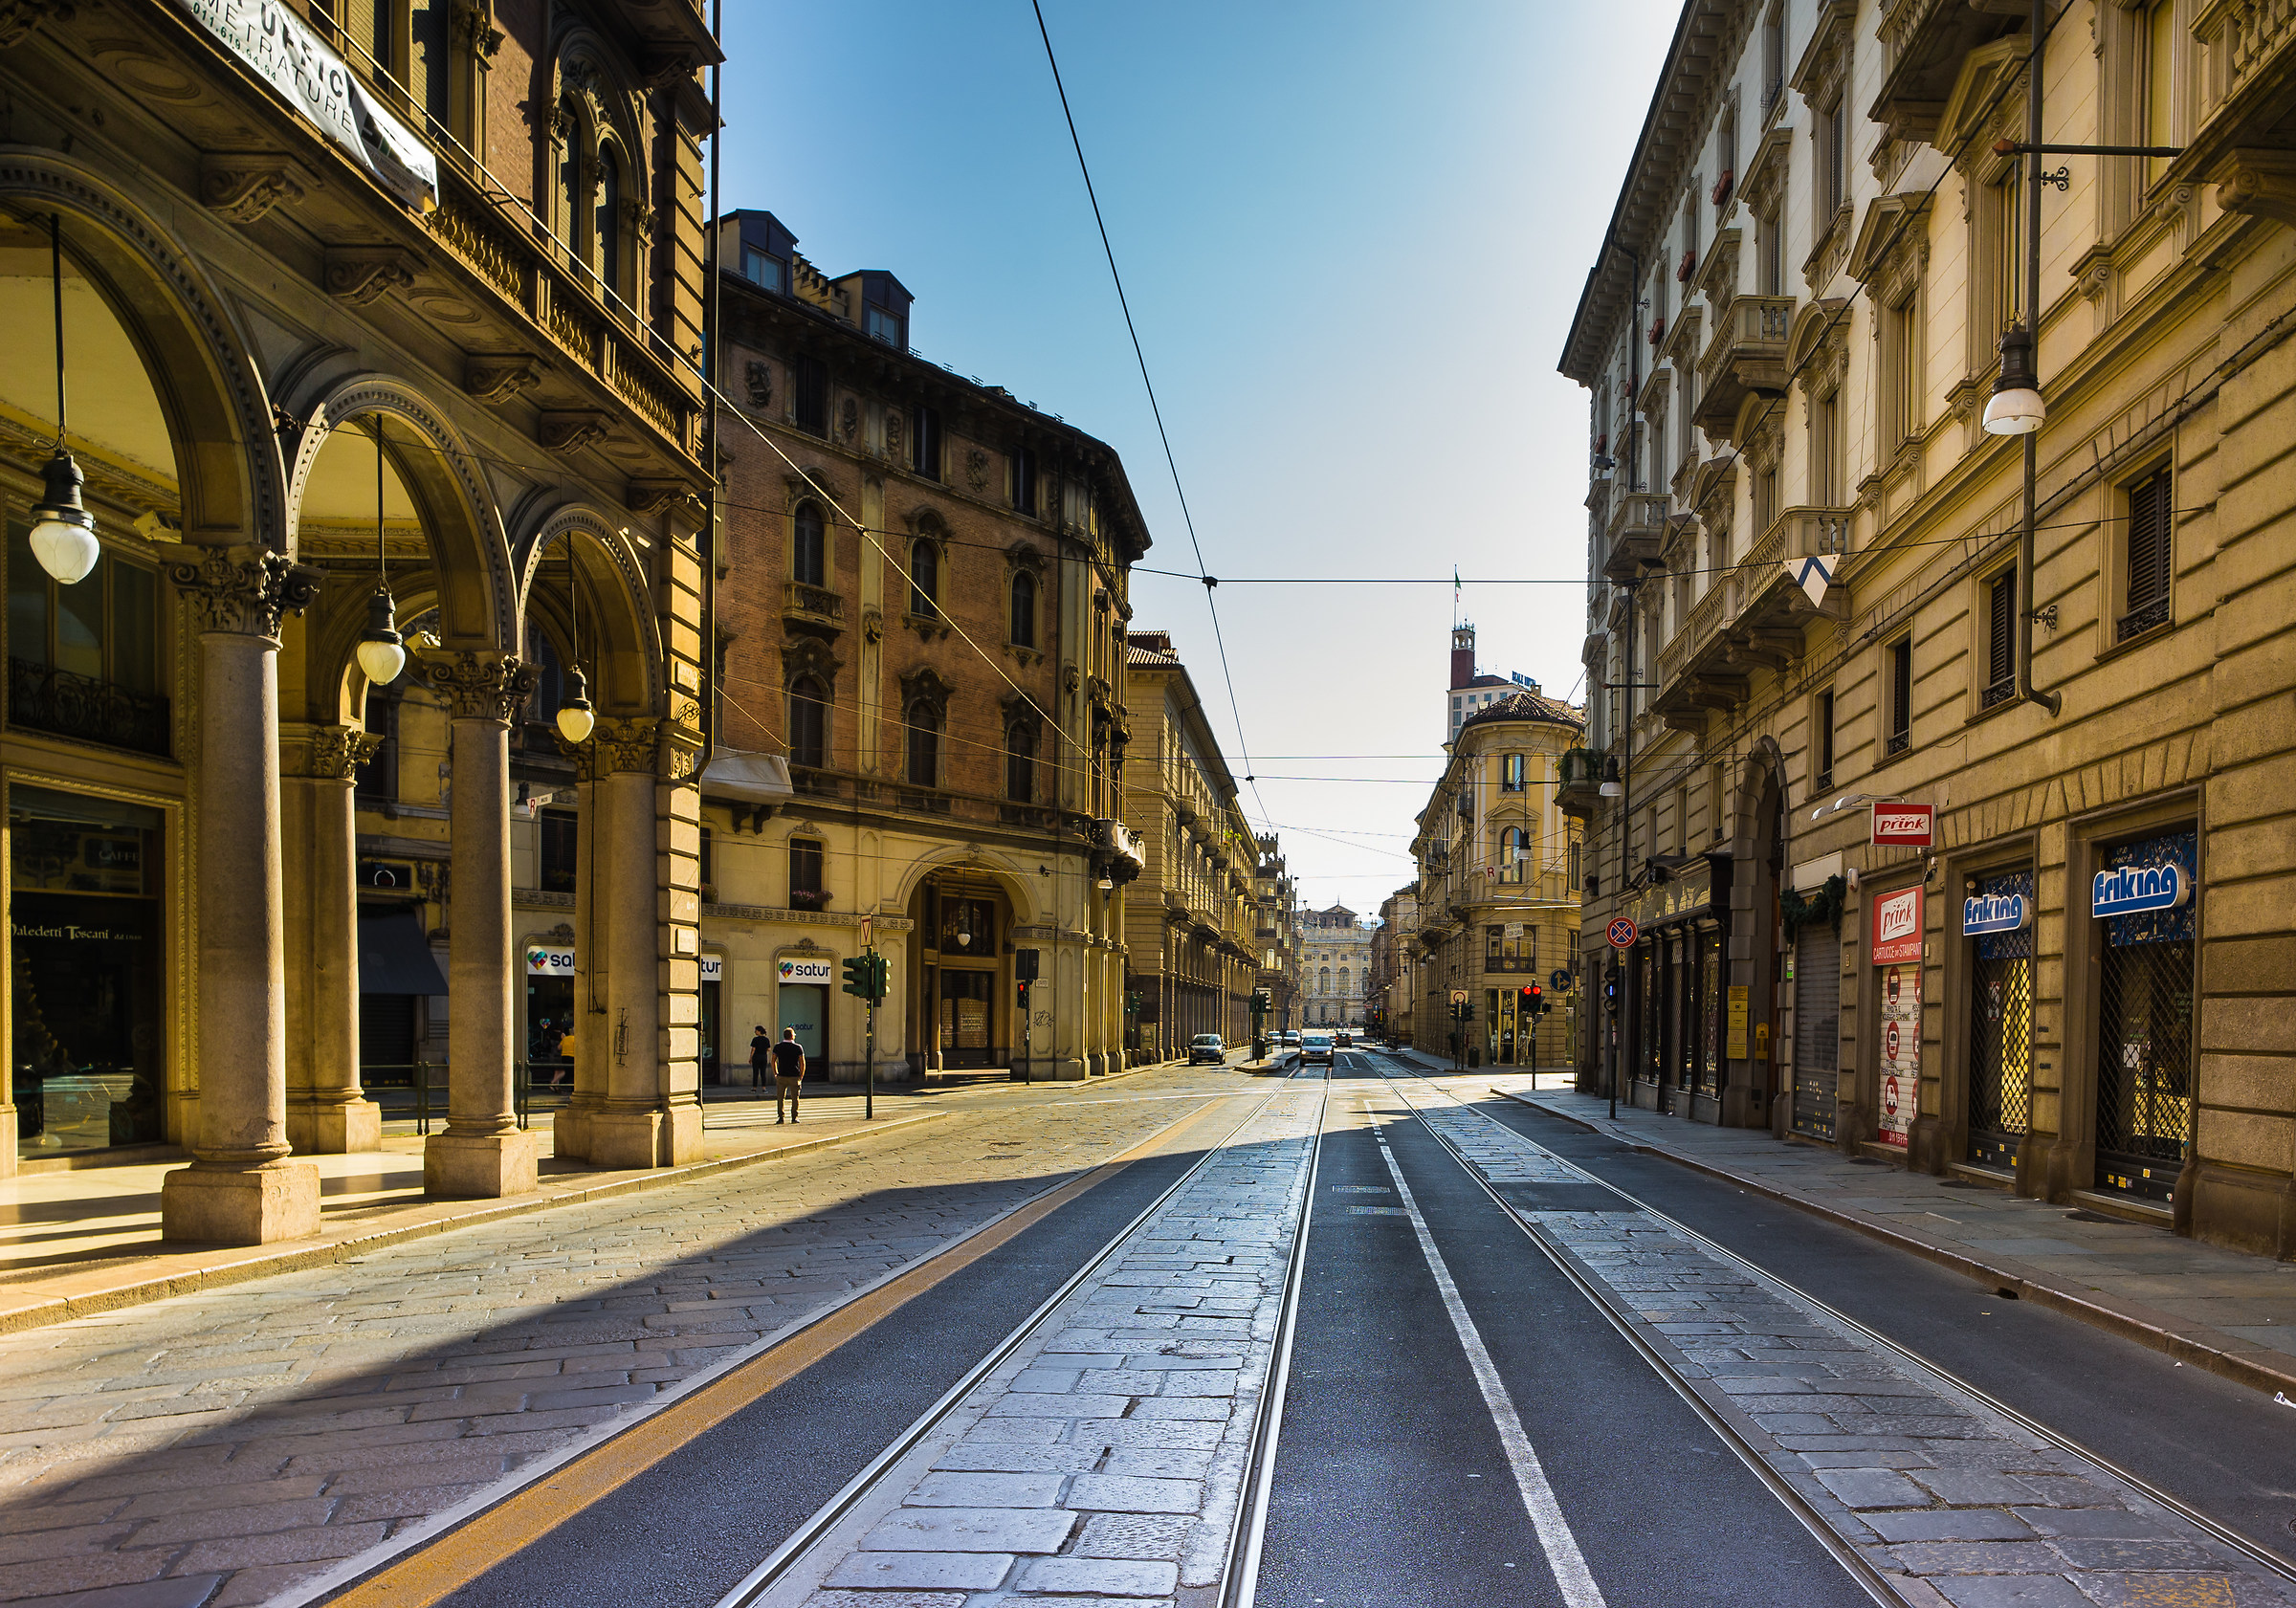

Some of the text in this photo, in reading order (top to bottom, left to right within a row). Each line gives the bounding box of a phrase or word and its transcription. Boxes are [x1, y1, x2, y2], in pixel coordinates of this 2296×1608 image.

[192, 2, 276, 81] 011.619.94.94
[260, 3, 344, 98] UFFIC
[529, 799, 536, 813] R
[1880, 816, 1928, 832] prink
[1487, 867, 1495, 878] R
[2092, 865, 2178, 917] friking
[1883, 900, 1914, 936] prink
[1964, 893, 2023, 935] friking
[64, 925, 109, 940] Toscani
[1899, 942, 1922, 958] STAMPANT
[701, 958, 721, 974] tur
[795, 963, 830, 977] satur
[795, 1023, 813, 1031] satur
